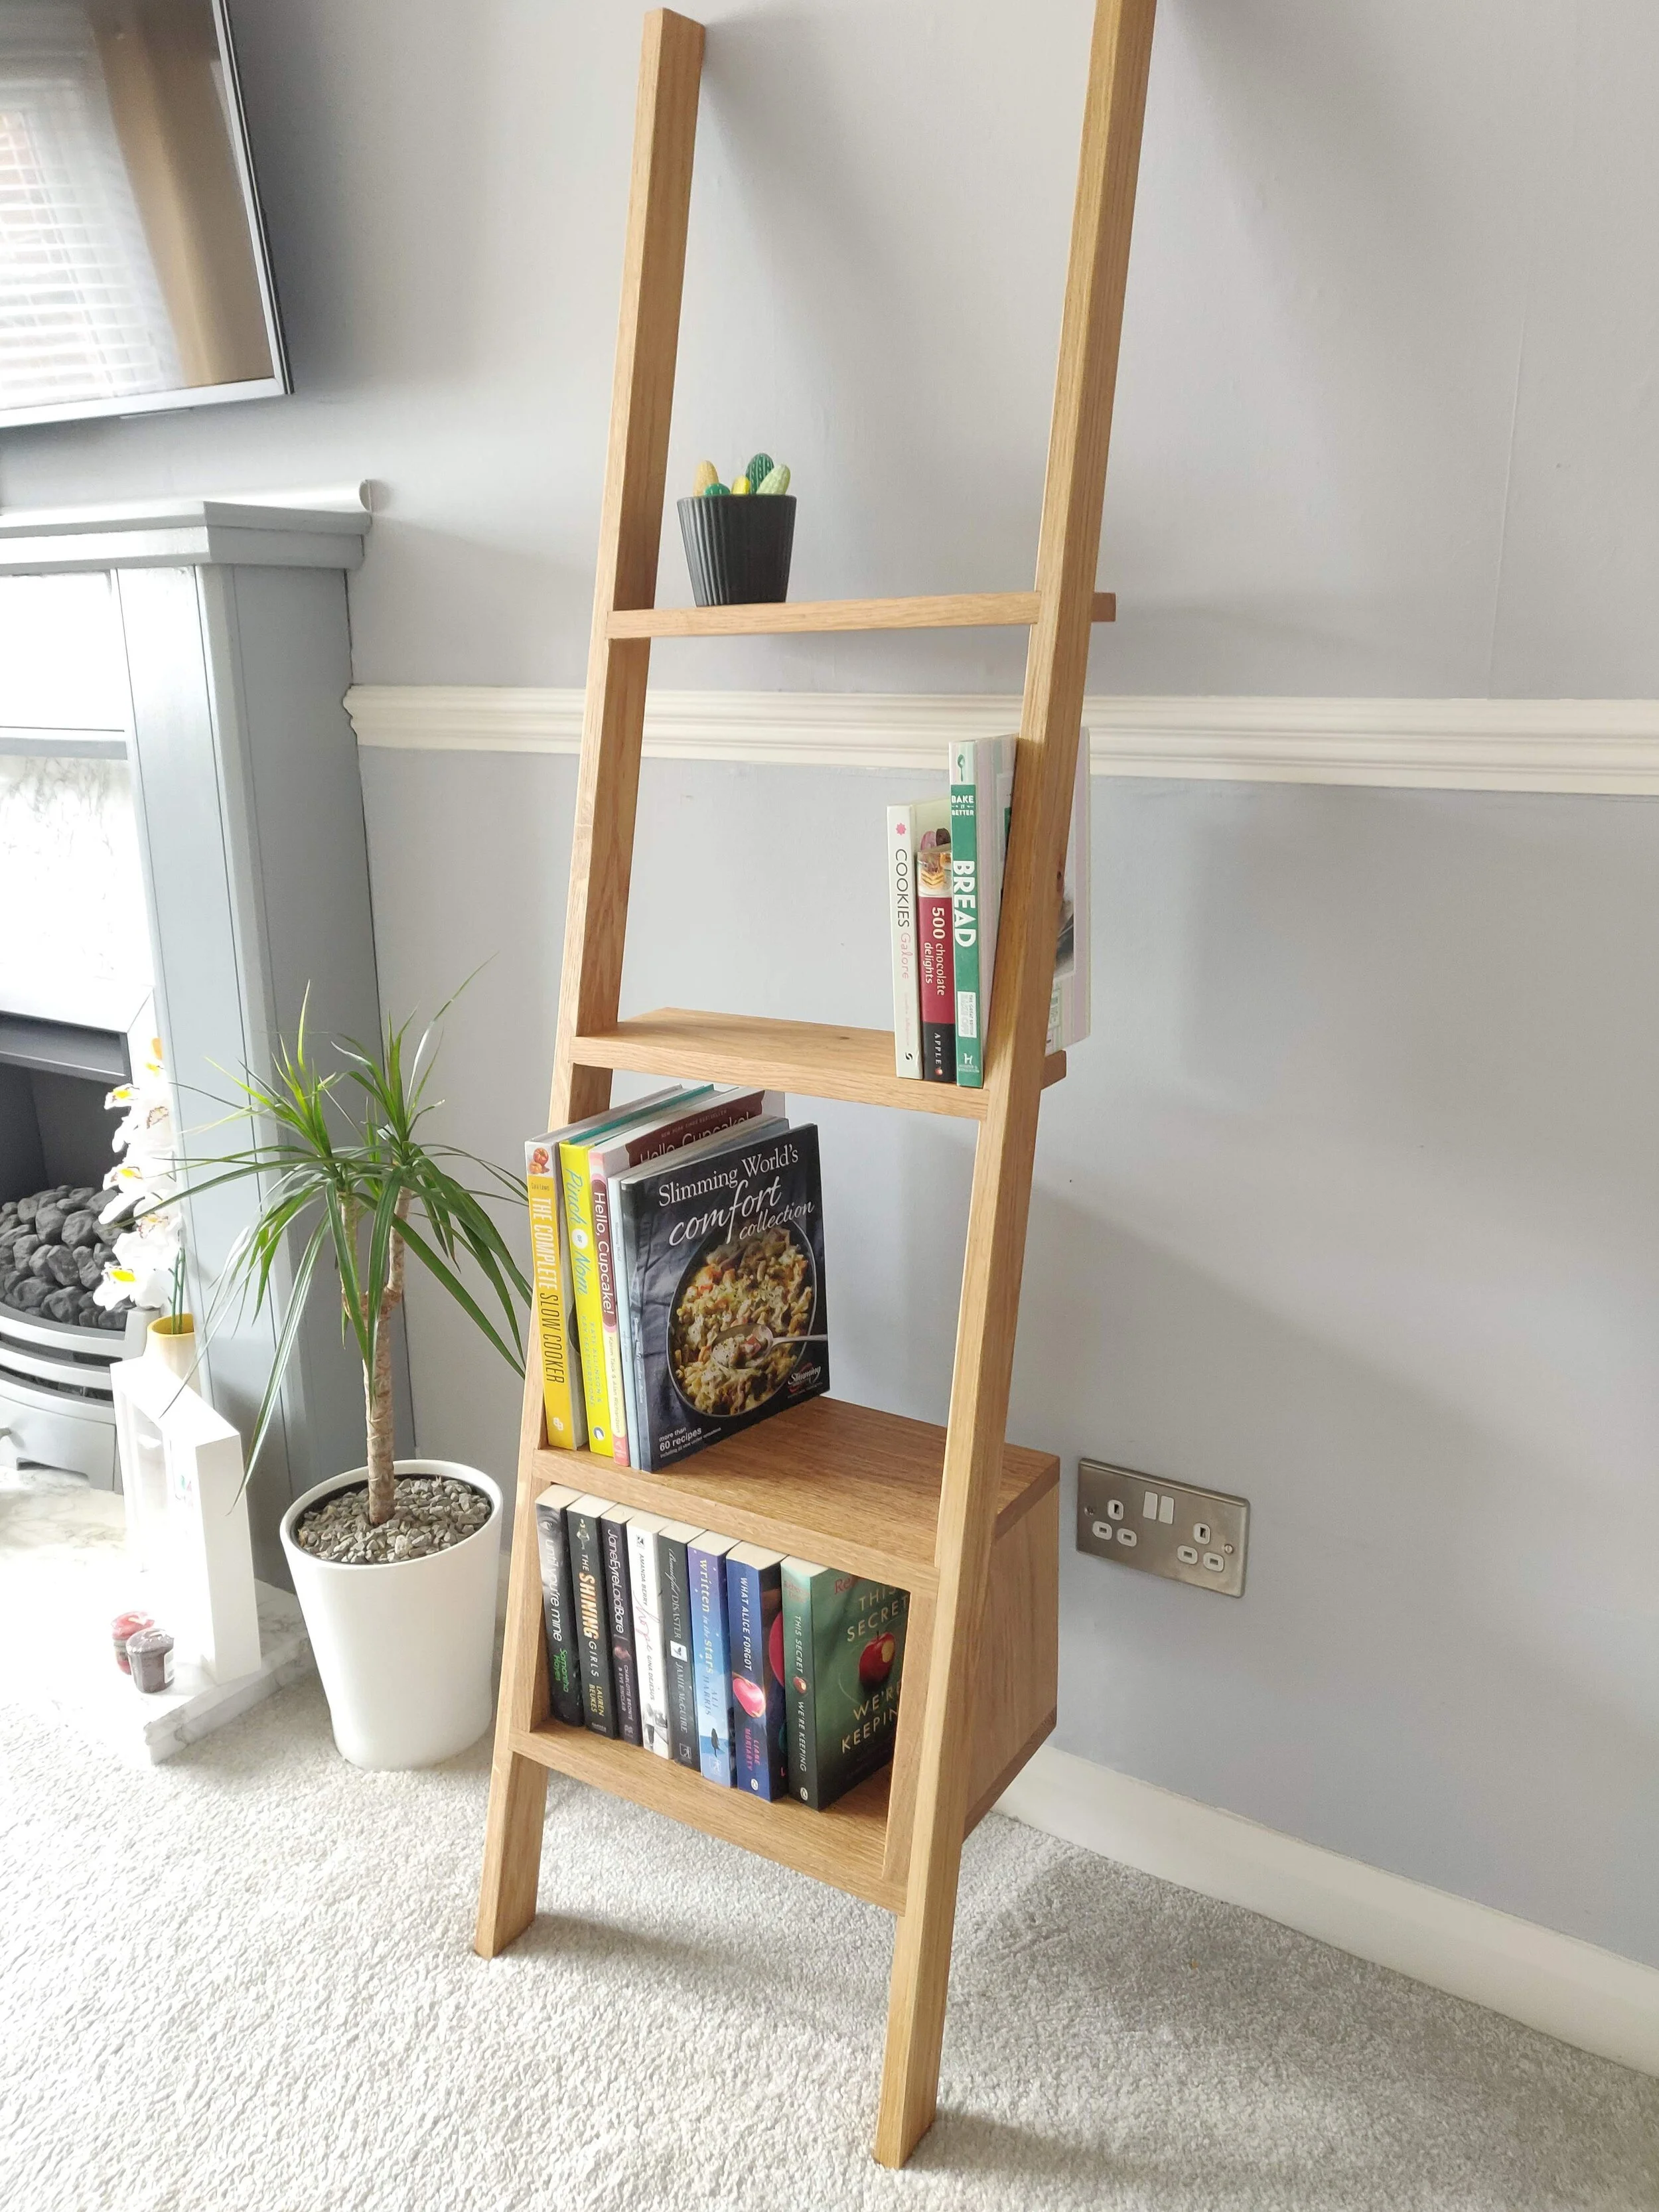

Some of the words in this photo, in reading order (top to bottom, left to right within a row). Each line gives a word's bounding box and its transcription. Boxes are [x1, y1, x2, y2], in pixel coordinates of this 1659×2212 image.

[951, 795, 974, 804] BAKE
[896, 849, 910, 927] COOKIES
[952, 860, 976, 947] BREAD
[932, 907, 946, 940] 500
[901, 932, 913, 980] Galore
[923, 942, 934, 984] delights
[936, 942, 947, 996] chocolate
[658, 1169, 738, 1207] Slimming
[741, 1143, 799, 1178] World's
[531, 1197, 552, 1221] THE
[565, 1168, 588, 1228] Pinch
[594, 1192, 608, 1236] Hello,
[669, 1175, 782, 1246] comfort
[739, 1200, 814, 1240] collection
[534, 1226, 557, 1290] COMPLETE
[575, 1248, 592, 1295] Nom
[598, 1241, 614, 1315] Cupcake!
[540, 1293, 561, 1335] SLOW
[543, 1335, 565, 1384] COOKER
[659, 1432, 674, 1442] more
[674, 1427, 686, 1437] than
[660, 1440, 670, 1451] 60
[672, 1428, 702, 1447] recipes
[664, 1548, 680, 1597] Beautiful
[699, 1560, 711, 1613] written
[740, 1577, 749, 1605] WHAT
[551, 1609, 563, 1642] mine
[579, 1572, 599, 1640] SHINING
[589, 1640, 599, 1678] GIRLS
[671, 1595, 681, 1639] DISASTER
[741, 1605, 751, 1635] ALICE
[847, 1595, 908, 1642] SECRET
[704, 1639, 715, 1674] stars
[743, 1635, 753, 1672] FORGOT
[589, 1684, 597, 1713] BEUKES
[675, 1661, 684, 1692] JAMIE
[703, 1674, 712, 1716] HARRIS
[596, 1685, 605, 1716] LAUREN
[744, 1727, 753, 1771] MORIARTY
[798, 1731, 807, 1772] KEEPING
[841, 1707, 898, 1754] KEEPIN
